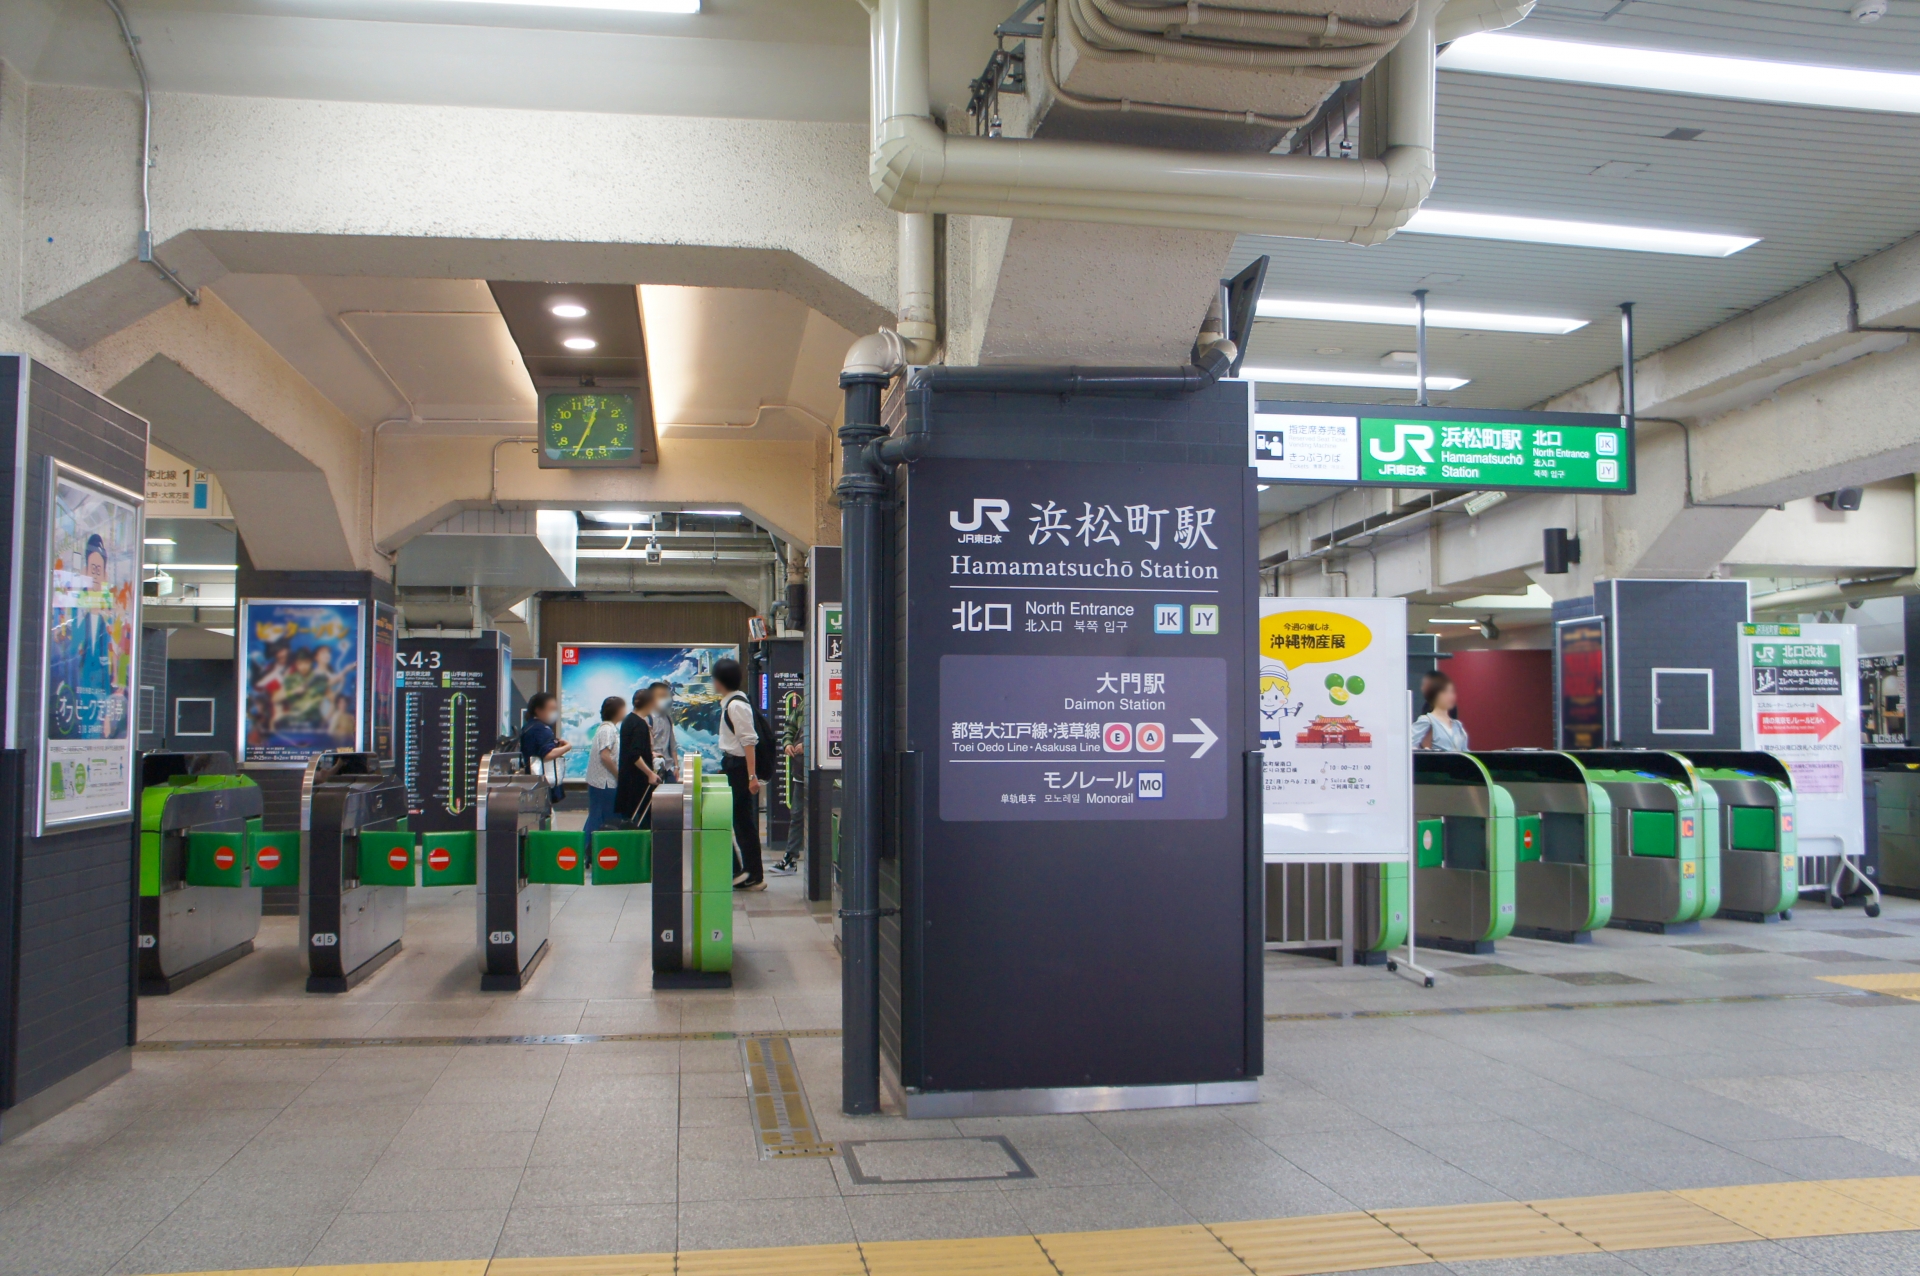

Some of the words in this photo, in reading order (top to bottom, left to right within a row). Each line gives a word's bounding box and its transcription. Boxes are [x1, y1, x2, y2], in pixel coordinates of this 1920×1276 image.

[571, 401, 583, 411] 11
[583, 398, 596, 407] 12
[600, 401, 606, 410] 1
[560, 410, 572, 419] 10
[611, 409, 619, 418] 2
[554, 422, 563, 432] 9
[616, 423, 625, 432] 3
[560, 436, 569, 446] 8
[610, 437, 620, 446] 4
[1369, 424, 1435, 463] JR
[1441, 426, 1523, 451] 浜松町駅
[1532, 429, 1562, 446] 北口
[585, 448, 594, 457] 6
[598, 445, 607, 454] 5
[1532, 447, 1555, 458] North
[1555, 449, 1590, 459] Entrance
[1533, 459, 1556, 468] 北入口
[1378, 464, 1427, 476] JR東日本
[1441, 465, 1479, 478] Station
[182, 469, 191, 488] 1
[949, 498, 1011, 533] JR
[1028, 500, 1219, 551] 浜松町駅
[957, 533, 1002, 544] JR東日本
[950, 555, 1134, 578] Hamamatsuchō
[1140, 559, 1219, 580] Station
[1025, 600, 1065, 615] North
[1070, 602, 1134, 616] Entrance
[952, 600, 1012, 632] 北口
[1159, 612, 1178, 626] JK
[1195, 612, 1214, 627] JY
[1024, 619, 1062, 633] 北入口
[1074, 620, 1099, 633] 북쪽
[1104, 620, 1129, 633] 입구
[1270, 634, 1346, 649] 沖縄物産展
[1755, 646, 1775, 659] JR
[1782, 645, 1827, 658] 北口改札
[1096, 672, 1165, 694] 大門駅
[1064, 697, 1115, 710] Daimon
[1119, 698, 1166, 711] Station
[952, 742, 975, 752] Toei
[976, 742, 1005, 752] Oedo
[1079, 742, 1101, 752] Line
[1043, 770, 1134, 789] モノレール
[1139, 779, 1161, 791] MO
[1000, 793, 1037, 804] 单轨电车
[1043, 793, 1081, 804] 모노레일
[1086, 793, 1134, 804] Monorail
[1395, 913, 1400, 921] 9
[316, 935, 322, 943] 4
[327, 935, 333, 943] 5
[665, 932, 671, 940] 6
[713, 931, 720, 939] 7
